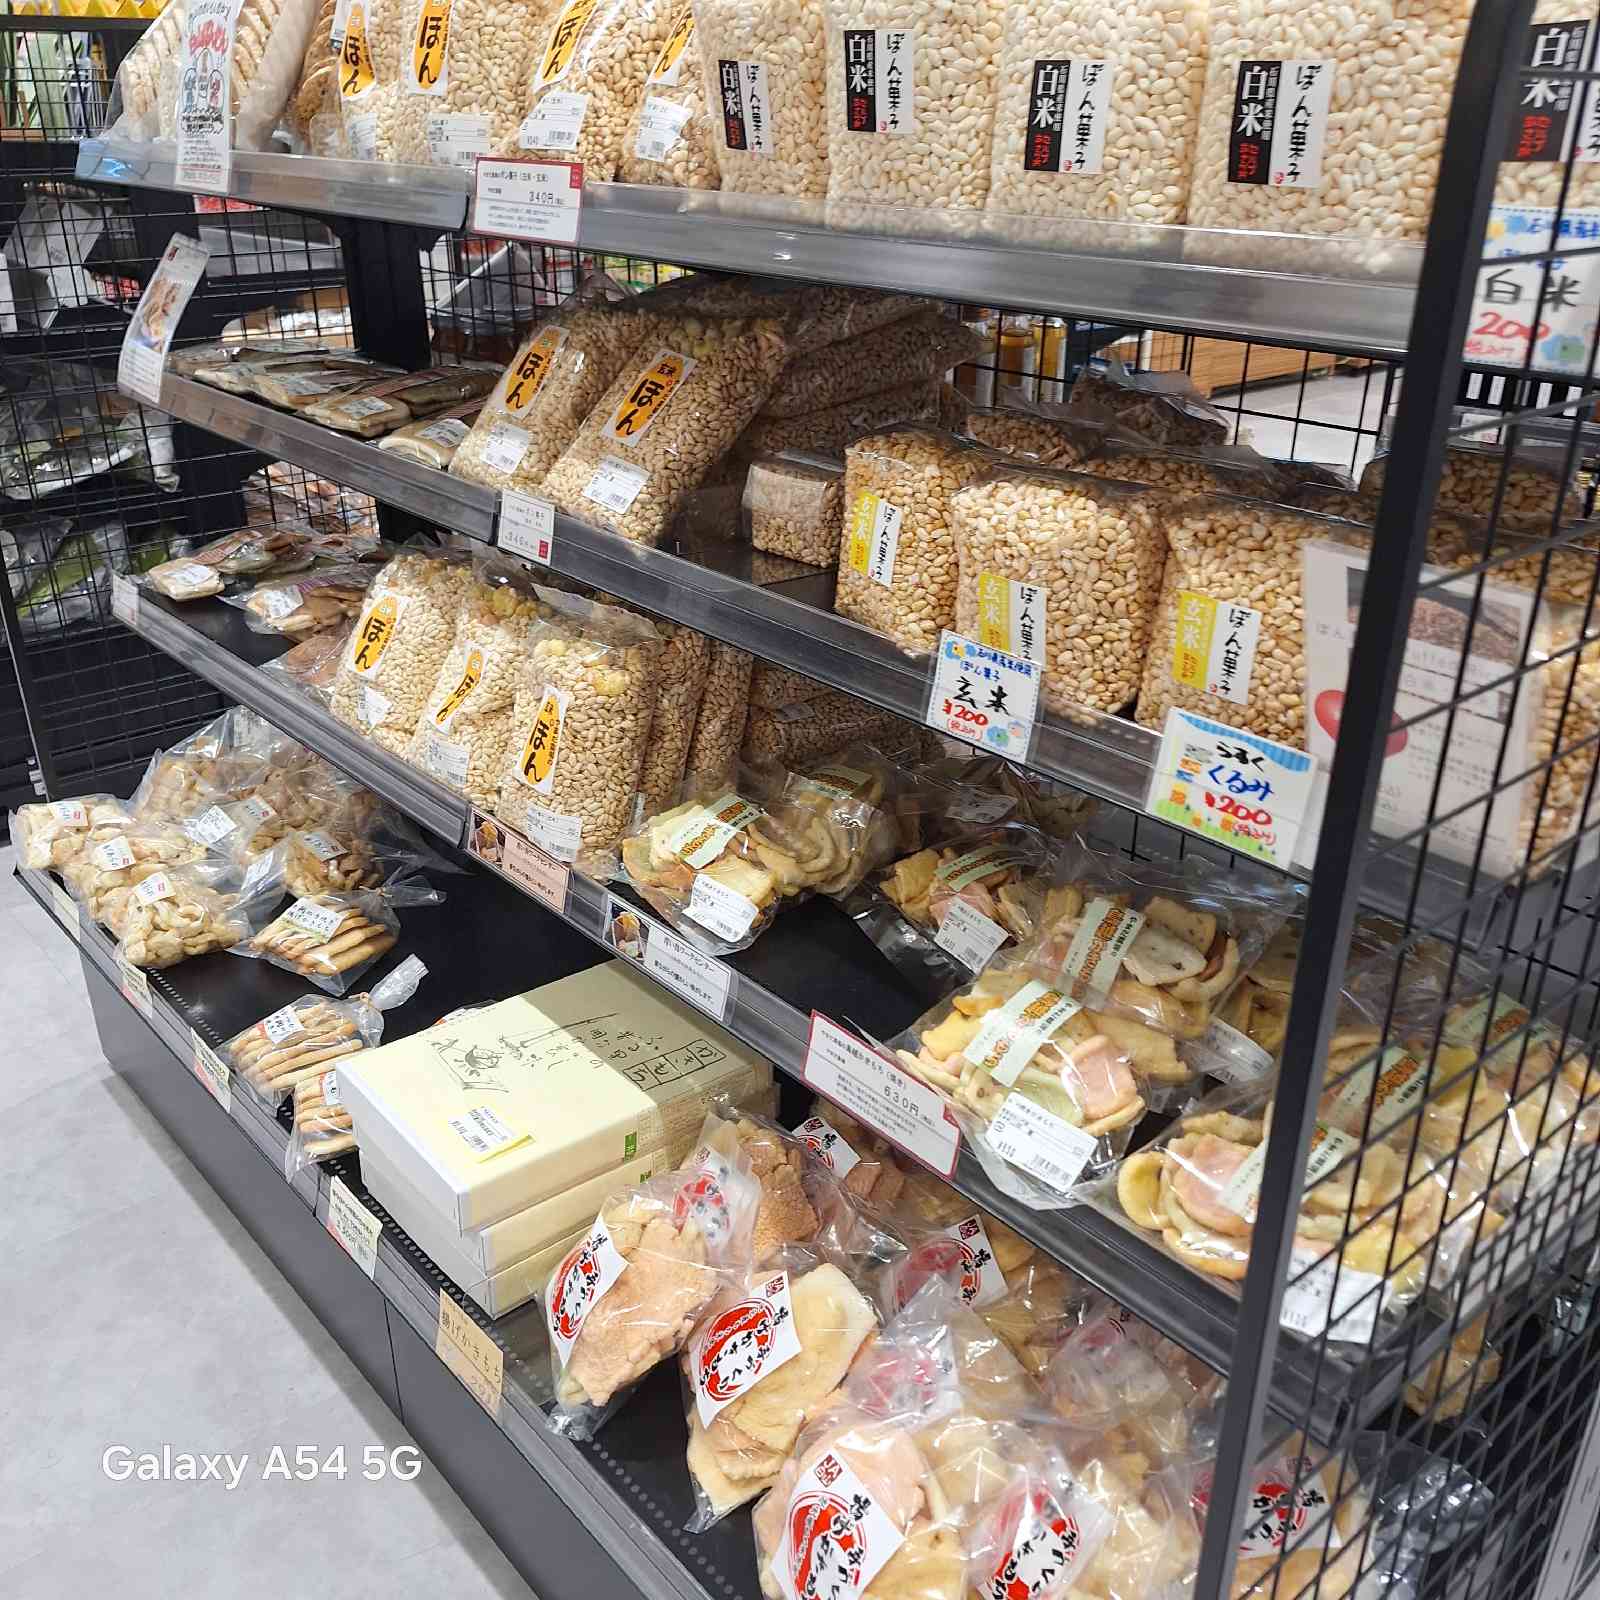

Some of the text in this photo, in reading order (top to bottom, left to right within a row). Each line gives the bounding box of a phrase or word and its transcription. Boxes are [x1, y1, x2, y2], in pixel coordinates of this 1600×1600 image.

[721, 63, 738, 117] 白米
[848, 34, 868, 93] 白米
[886, 33, 905, 130] ぽん菓子
[1031, 64, 1060, 129] 白米
[1520, 27, 1571, 109] 白米
[746, 64, 763, 150] ぽん菓子
[1073, 64, 1105, 170] ぽん菓子
[1236, 65, 1269, 137] 白米
[1286, 65, 1322, 183] ぽん菓子
[1182, 598, 1202, 649] 玄米
[1218, 607, 1252, 695] ぽん菓子
[951, 675, 1011, 716] 玄米
[1207, 763, 1274, 802] くるみ
[882, 1085, 920, 1117] 630円
[800, 1493, 873, 1600] 揚げかきも
